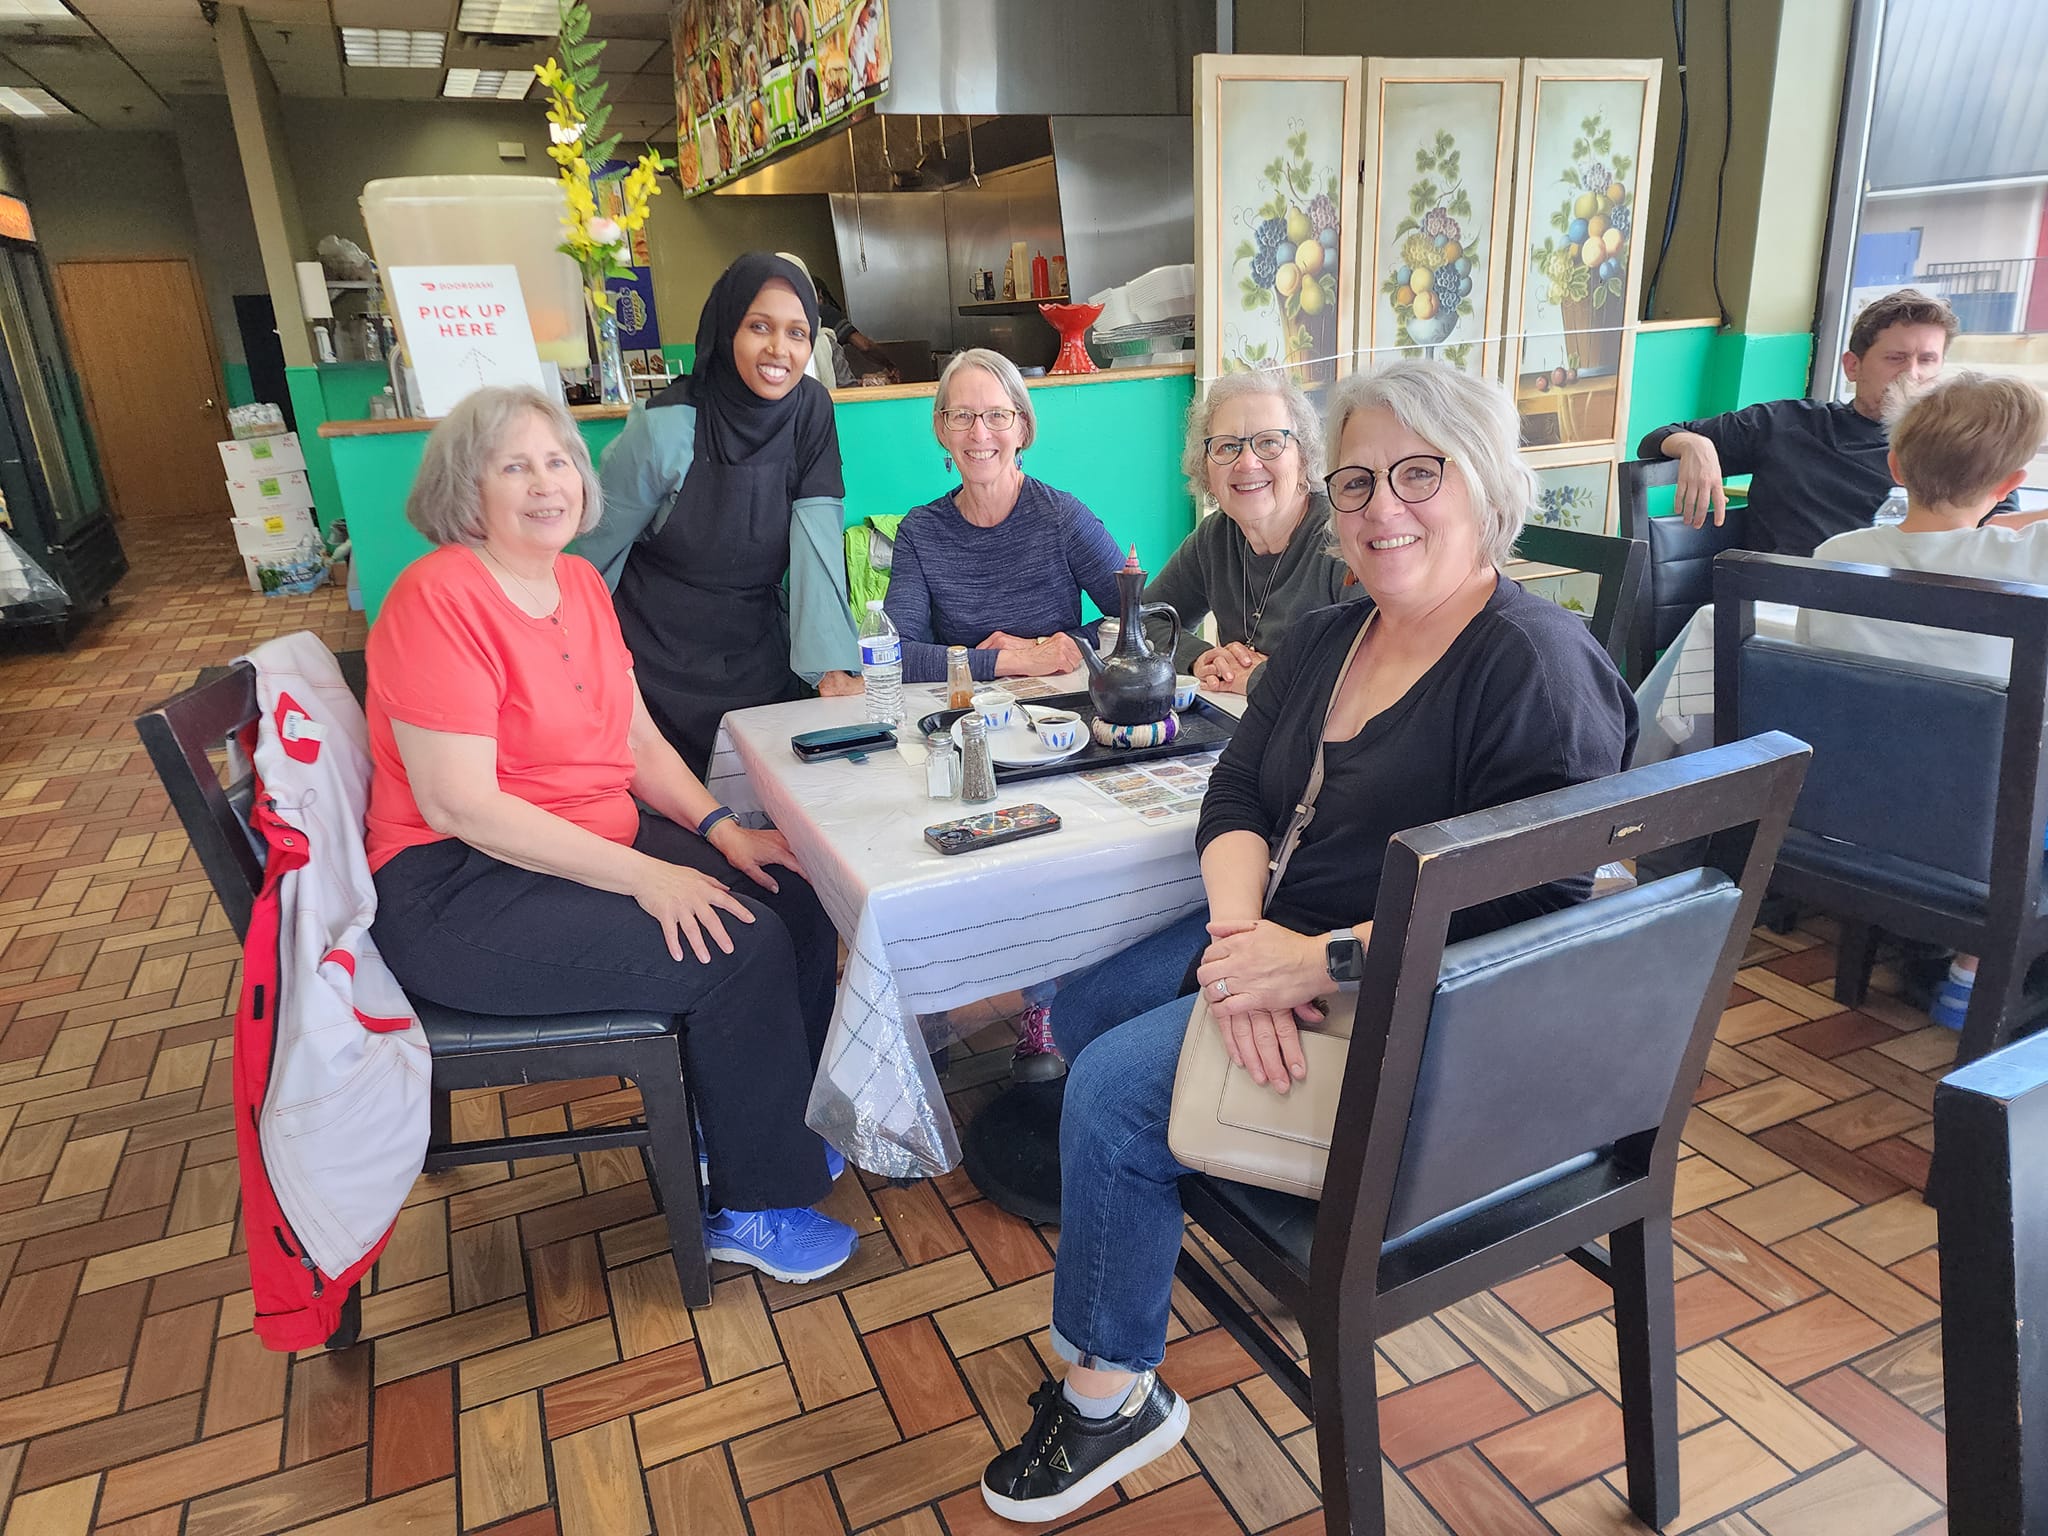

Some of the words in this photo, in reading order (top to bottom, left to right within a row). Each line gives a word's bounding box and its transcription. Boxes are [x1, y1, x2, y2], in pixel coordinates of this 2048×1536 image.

[418, 304, 472, 320] PICK
[477, 302, 506, 318] UP
[438, 320, 497, 337] HERE
